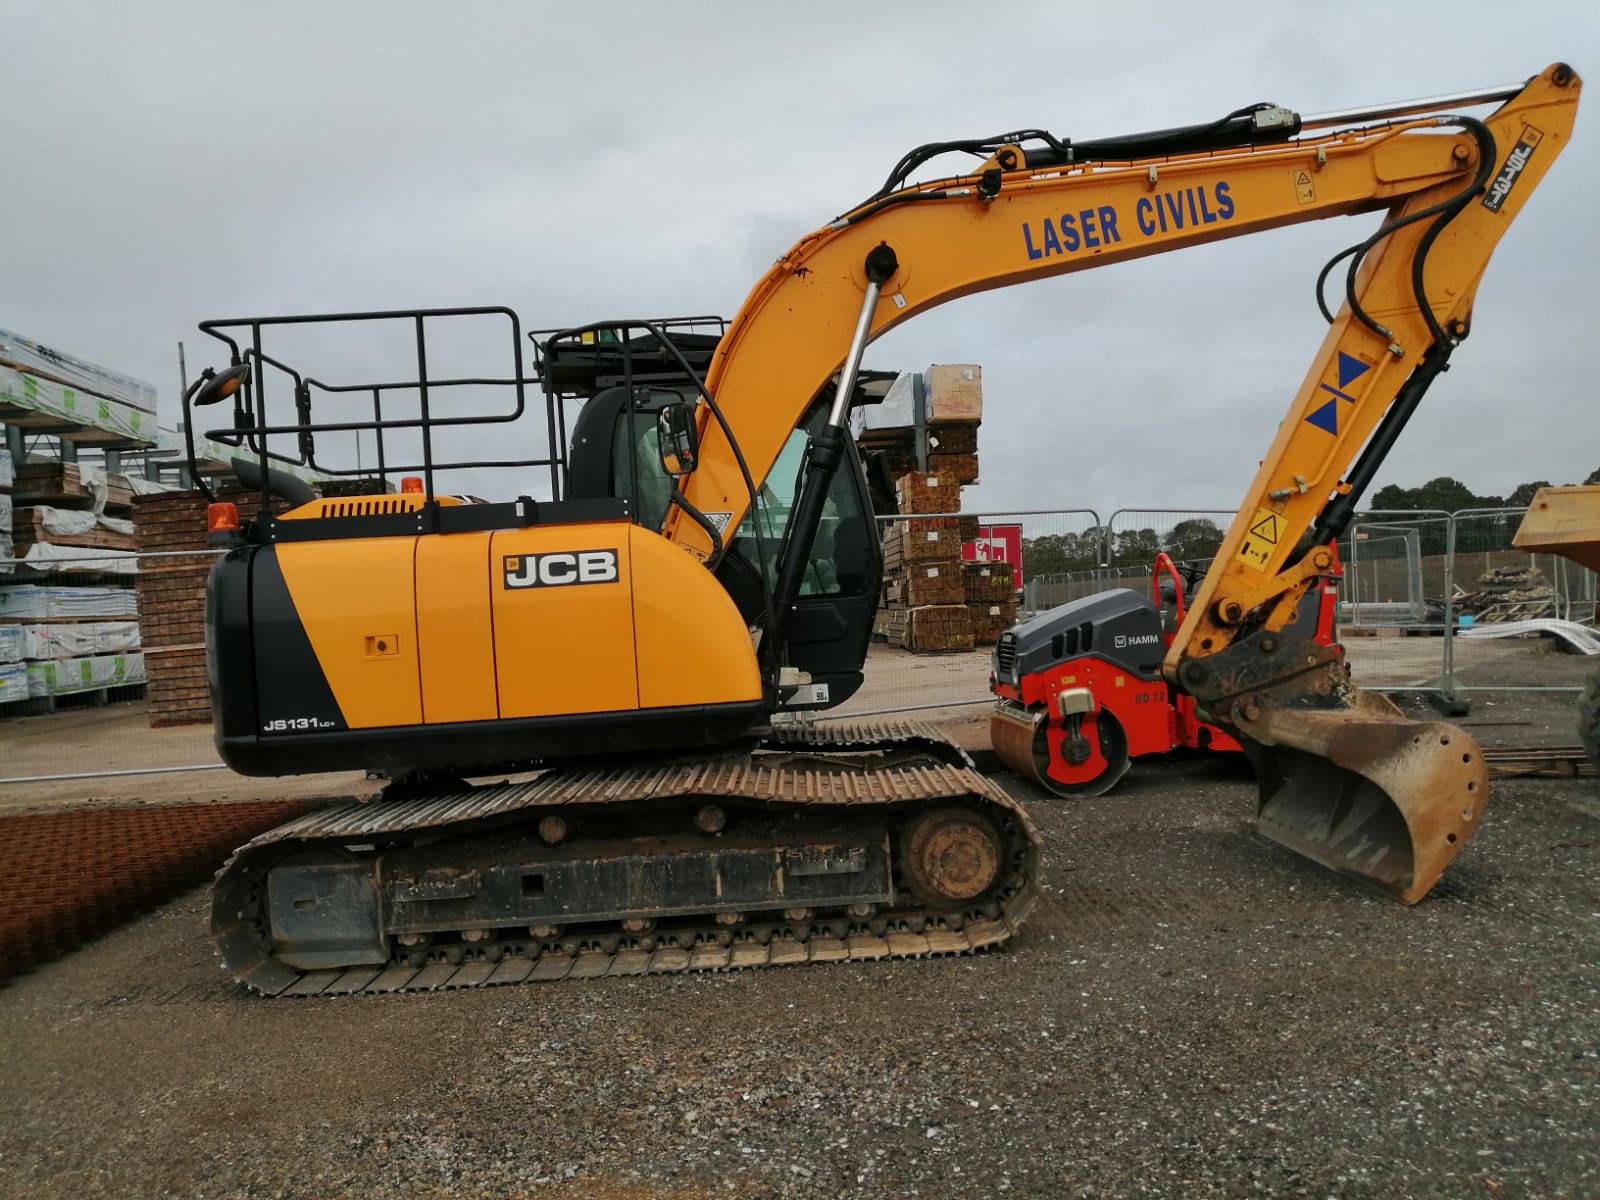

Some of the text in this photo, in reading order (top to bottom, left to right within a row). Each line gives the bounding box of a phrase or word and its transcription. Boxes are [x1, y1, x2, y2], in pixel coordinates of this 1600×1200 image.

[1022, 181, 1235, 260] LASER CIVILS
[506, 551, 617, 587] JCB
[1128, 634, 1159, 646] HAMM
[1135, 691, 1165, 704] HD 12
[263, 717, 318, 732] JS131
